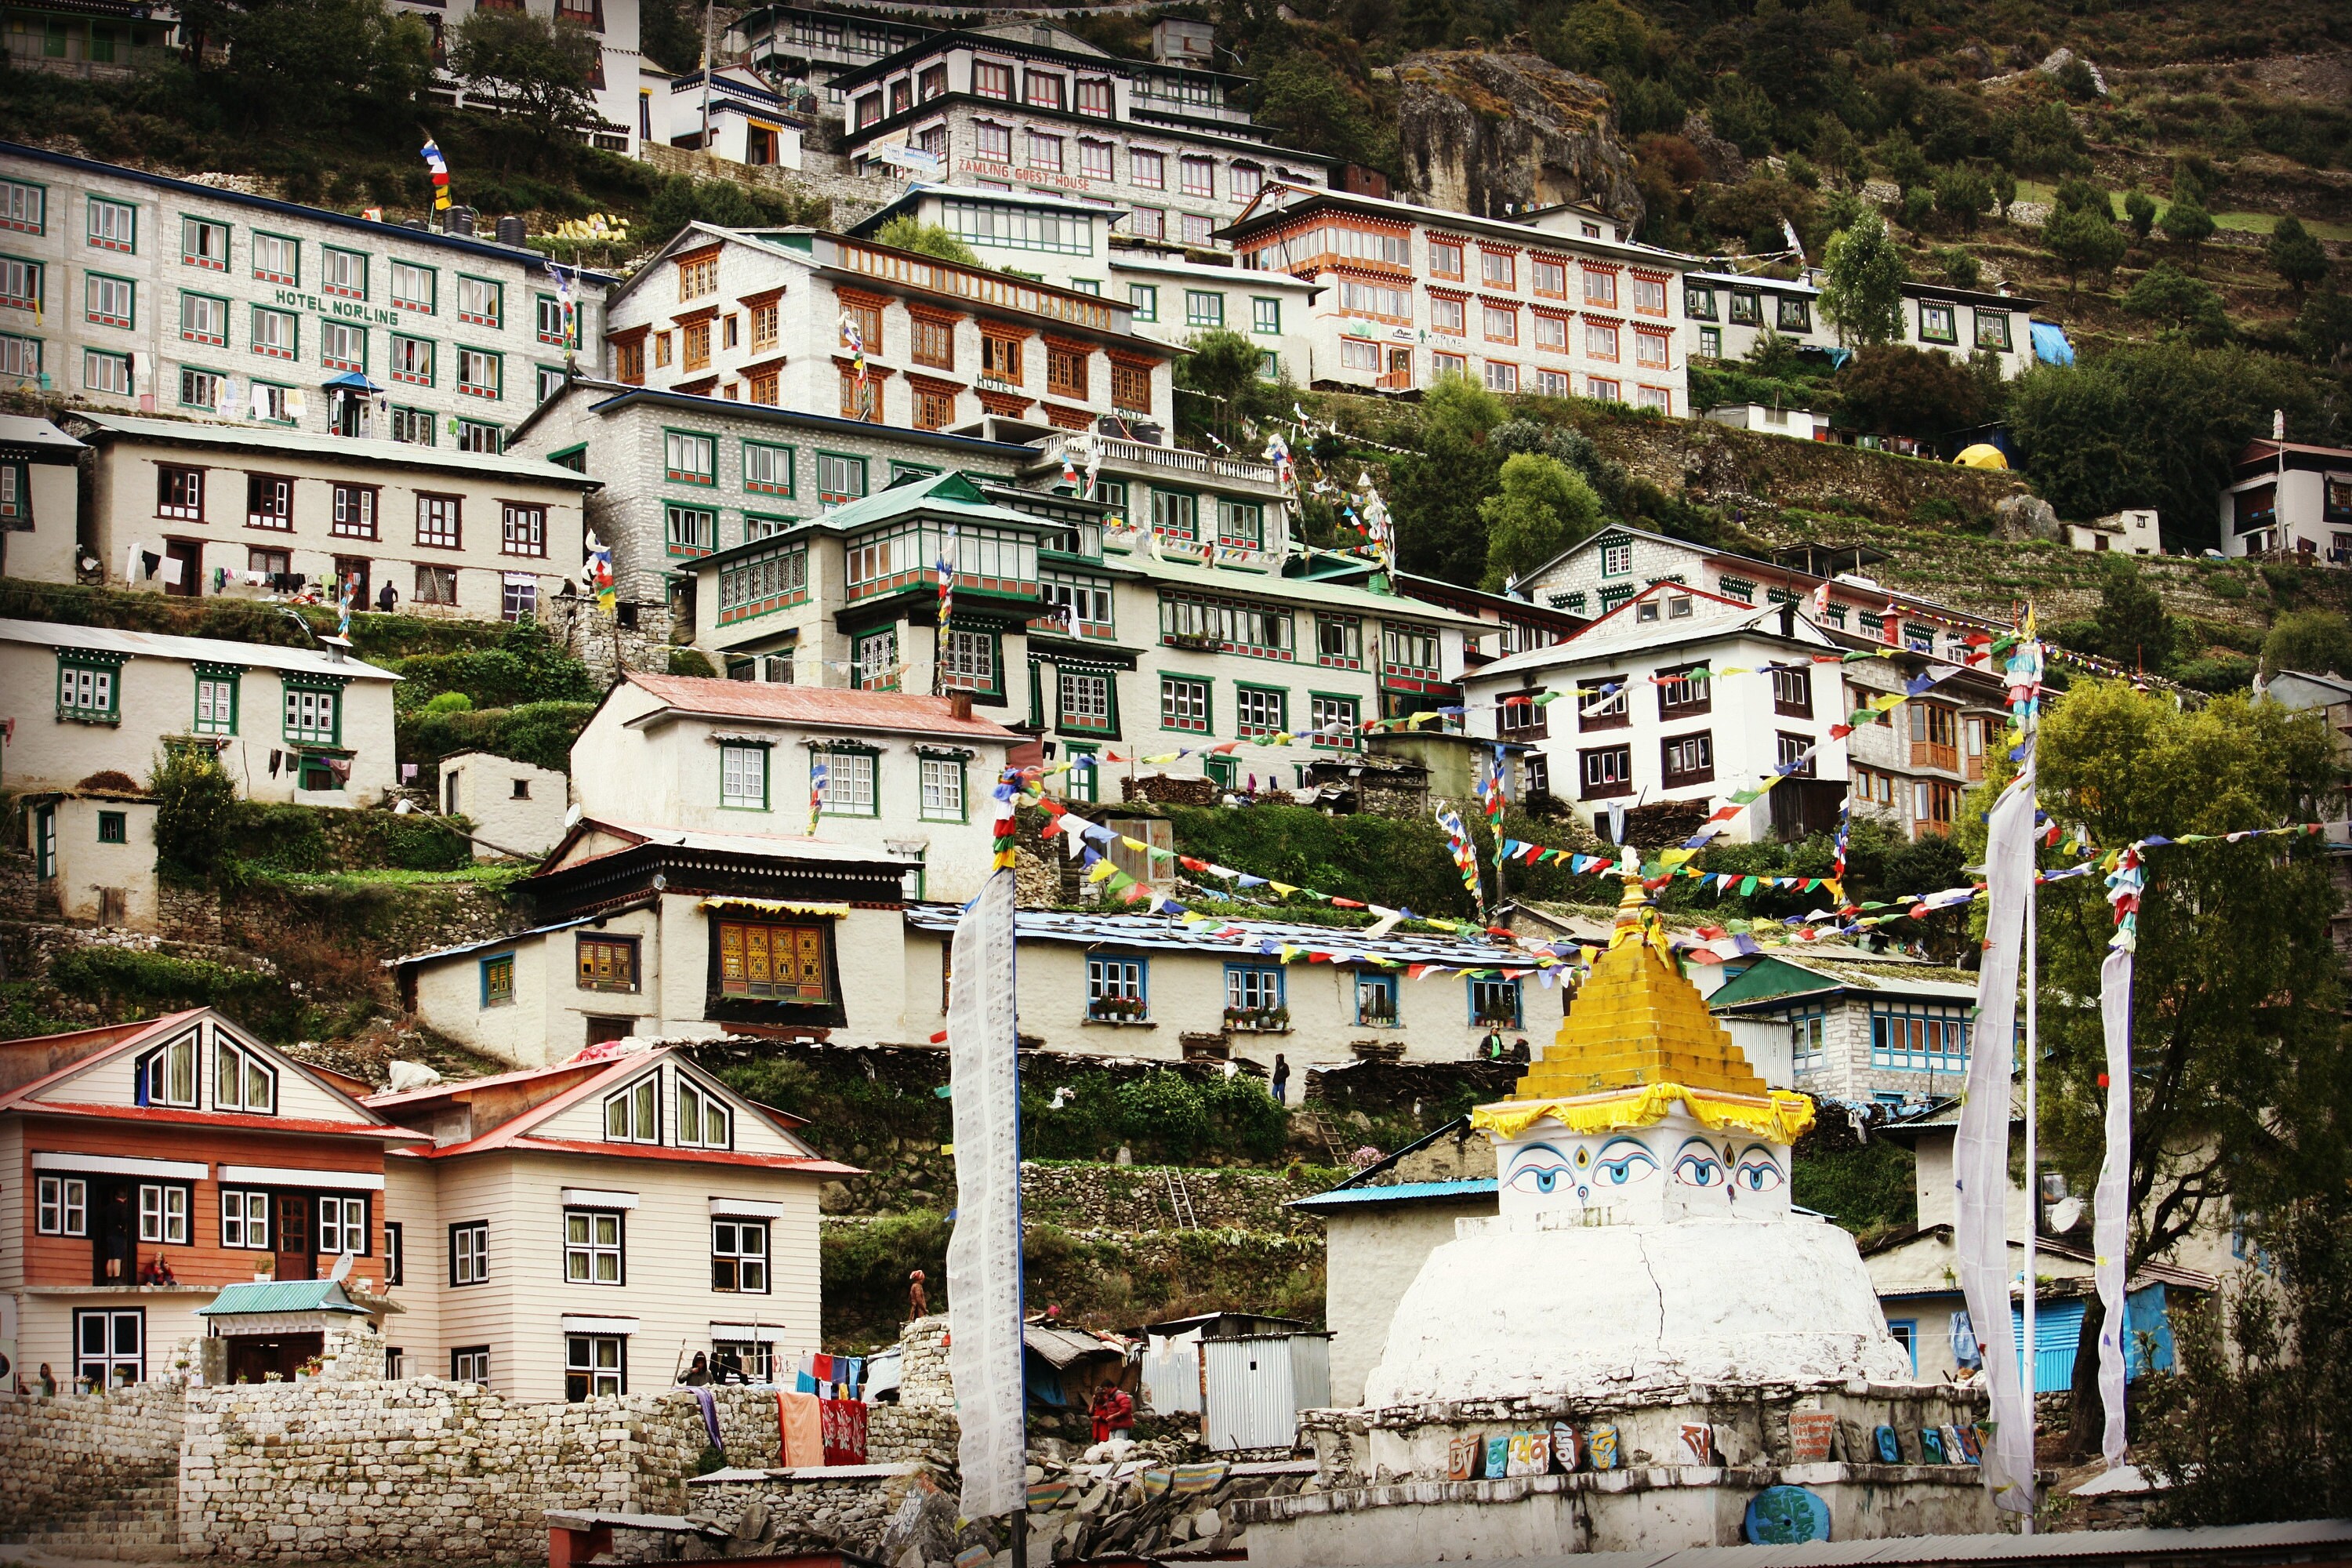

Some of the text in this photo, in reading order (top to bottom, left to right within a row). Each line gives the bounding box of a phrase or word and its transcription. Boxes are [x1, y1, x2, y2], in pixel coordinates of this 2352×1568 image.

[959, 158, 1090, 191] ZAMLING GUEST HOUSE
[275, 289, 398, 326] HOTEL NORLING
[977, 373, 1018, 395] HOTEL
